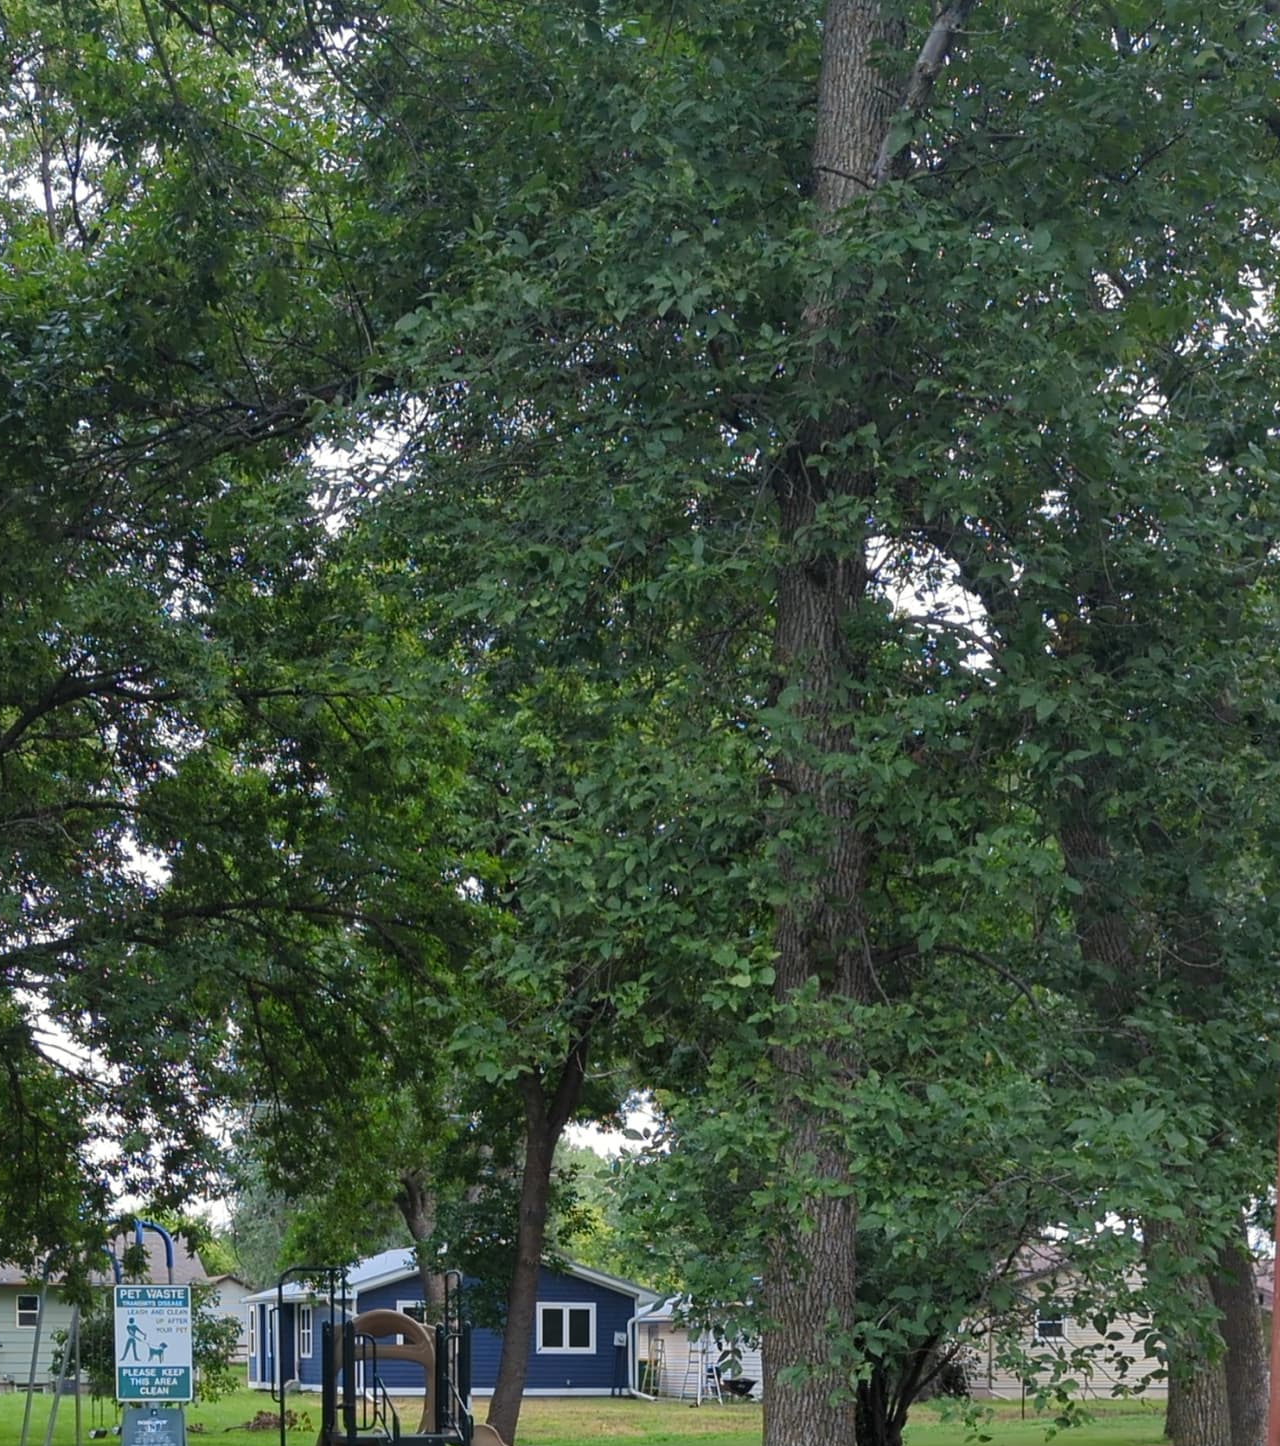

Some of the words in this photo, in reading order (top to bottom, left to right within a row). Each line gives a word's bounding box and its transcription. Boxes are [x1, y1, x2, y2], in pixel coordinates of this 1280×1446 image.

[120, 1289, 142, 1299] PET
[146, 1289, 185, 1299] WASTE
[122, 1368, 156, 1376] PLEASE
[162, 1368, 185, 1376] KEEP
[140, 1387, 169, 1395] CLEAN
